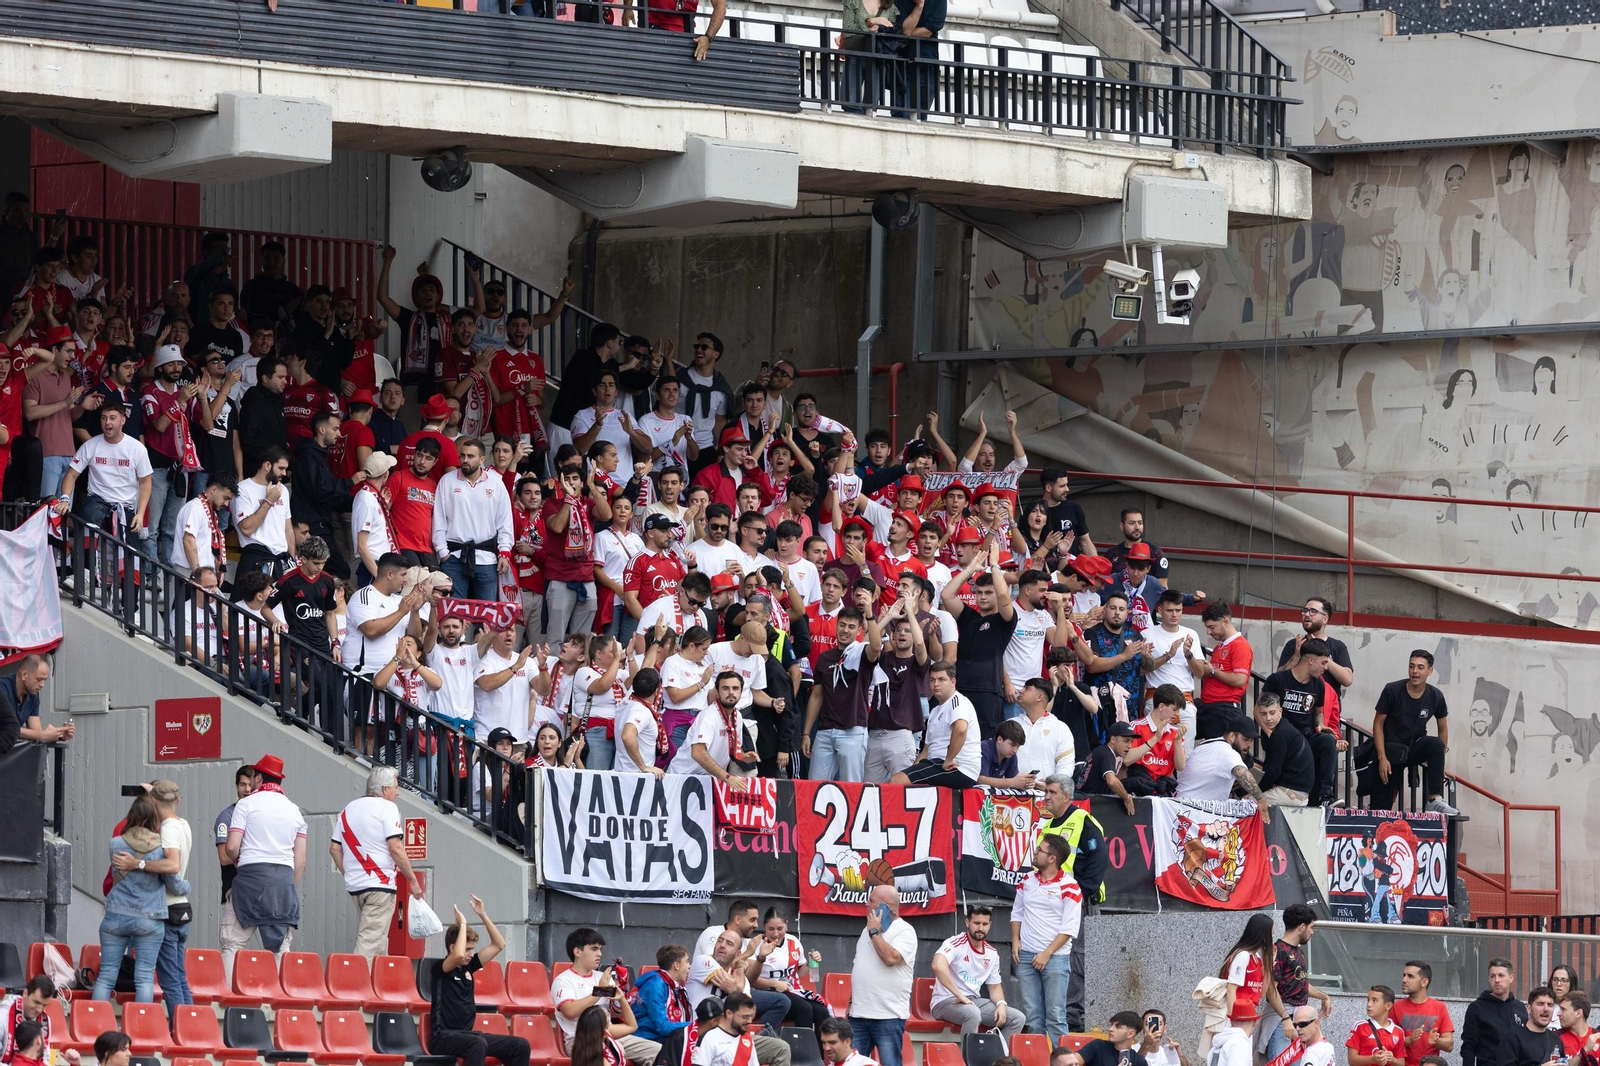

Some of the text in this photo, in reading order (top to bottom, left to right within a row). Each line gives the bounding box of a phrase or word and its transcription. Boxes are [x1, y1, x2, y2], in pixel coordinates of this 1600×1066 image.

[207, 342, 236, 357] dissolve
[298, 604, 324, 619] Mide
[1143, 752, 1169, 765] Midea
[588, 815, 668, 841] DONDE
[811, 781, 939, 867] 24-7
[689, 890, 712, 899] FANS
[1401, 1013, 1439, 1032] NIKE
